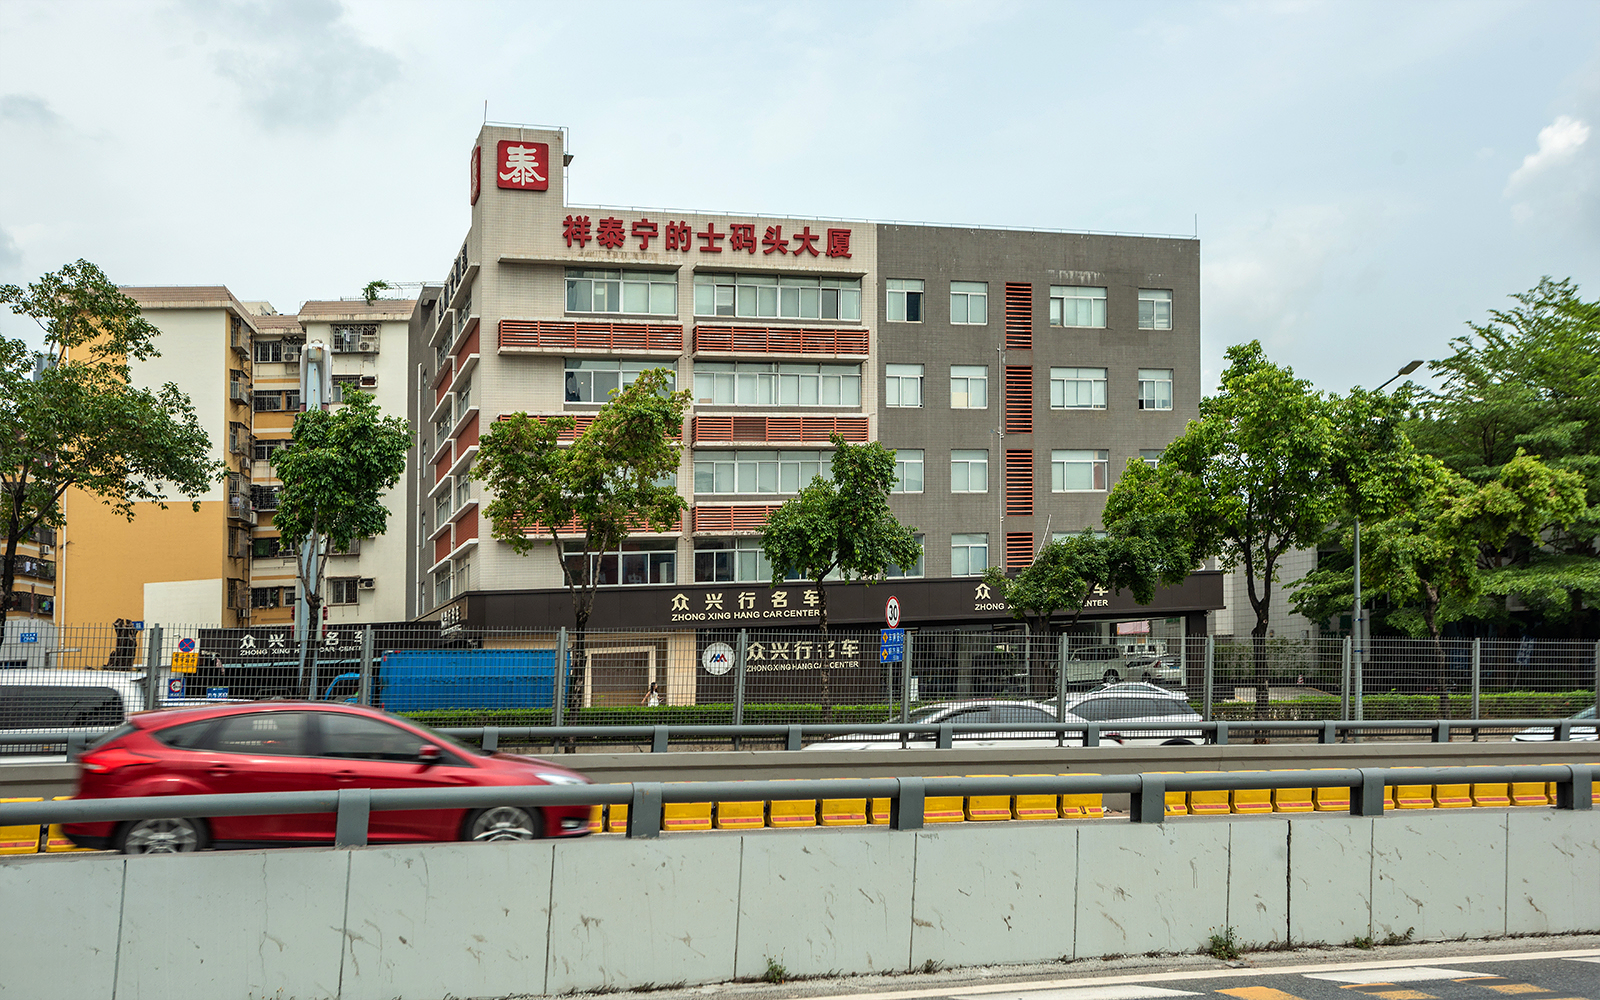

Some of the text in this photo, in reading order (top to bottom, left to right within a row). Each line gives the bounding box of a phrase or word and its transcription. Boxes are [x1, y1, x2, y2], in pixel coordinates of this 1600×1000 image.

[499, 144, 546, 187] 泰
[562, 214, 853, 258] 祥泰宁的士码头大厦
[671, 589, 820, 612] 众兴行名车
[974, 602, 1005, 611] ZHONG
[1077, 599, 1109, 608] NTER
[671, 608, 821, 622] ZHONG XING HANG CAR CENTER
[889, 604, 898, 621] 30
[239, 648, 268, 656] ZHONG
[829, 661, 859, 669] CENTER
